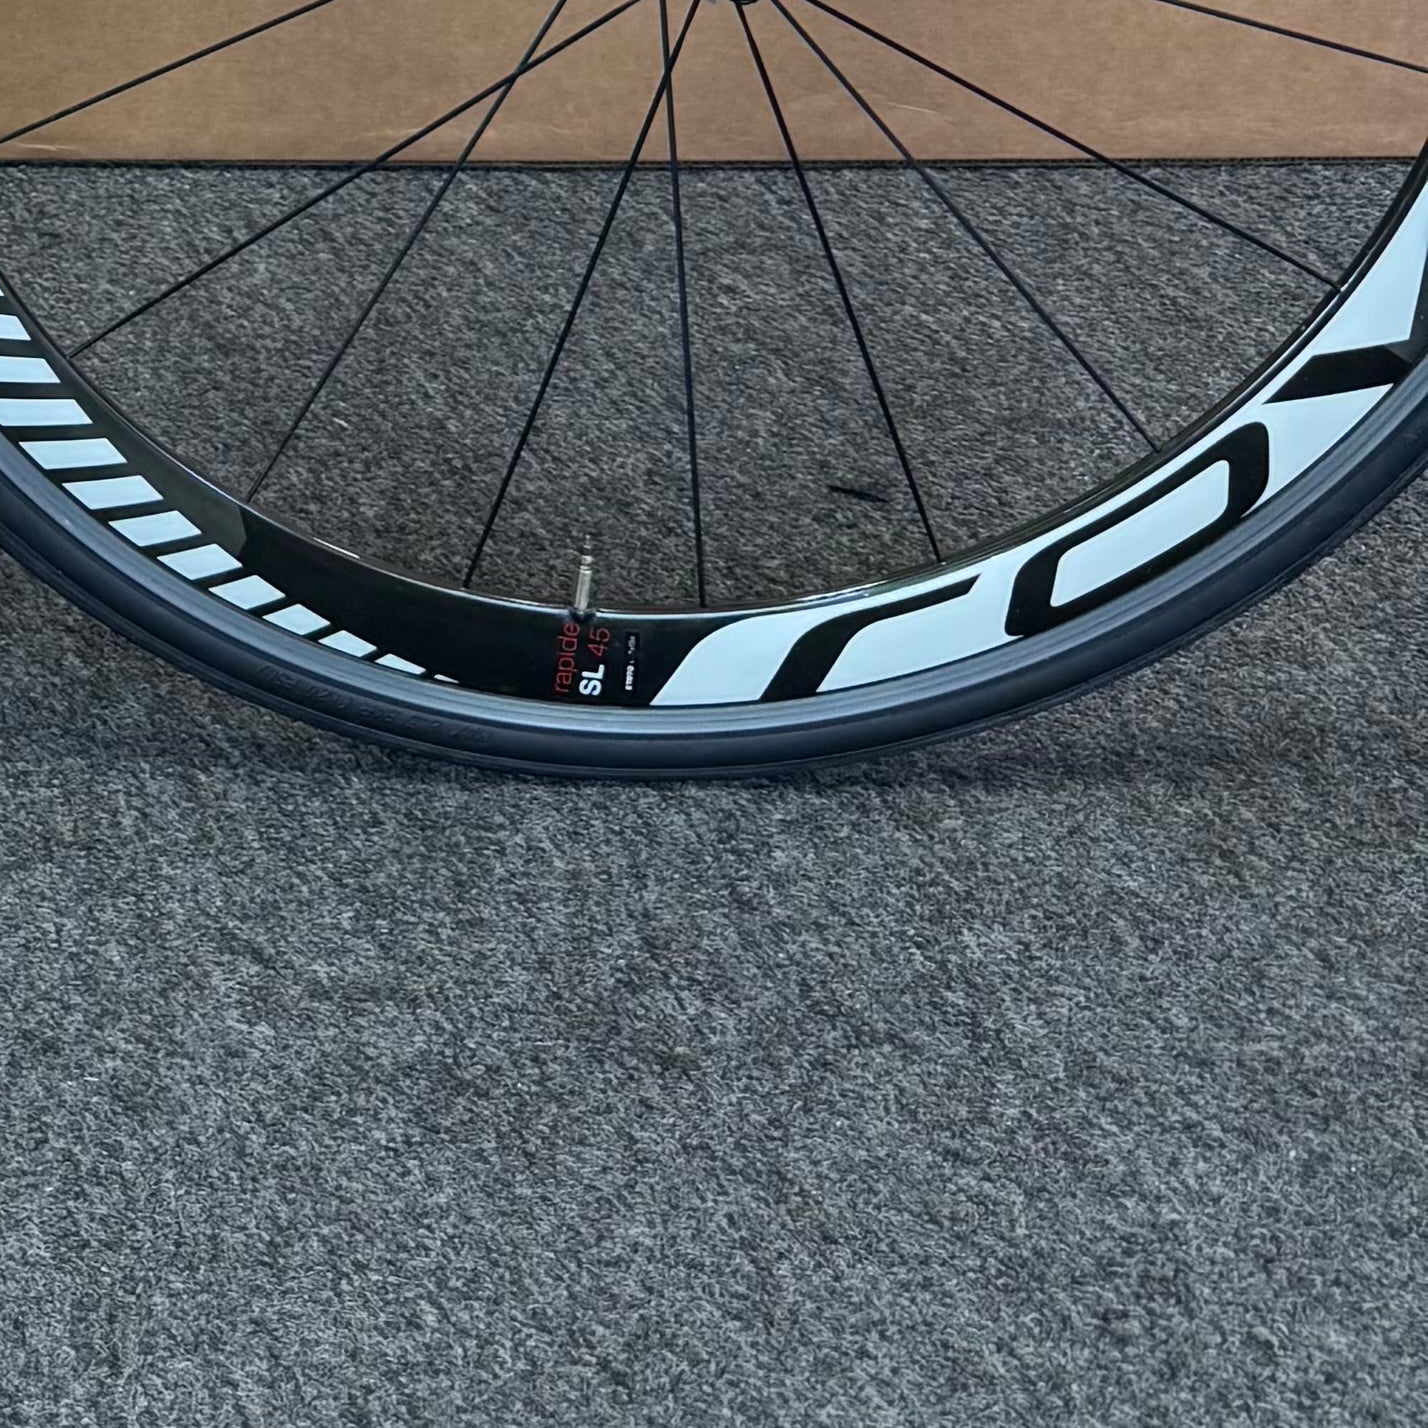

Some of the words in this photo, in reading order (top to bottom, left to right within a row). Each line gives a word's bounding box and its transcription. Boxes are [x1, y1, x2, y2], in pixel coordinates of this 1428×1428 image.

[553, 621, 581, 694] rapide
[587, 626, 611, 658] 45
[578, 664, 605, 696] SL
